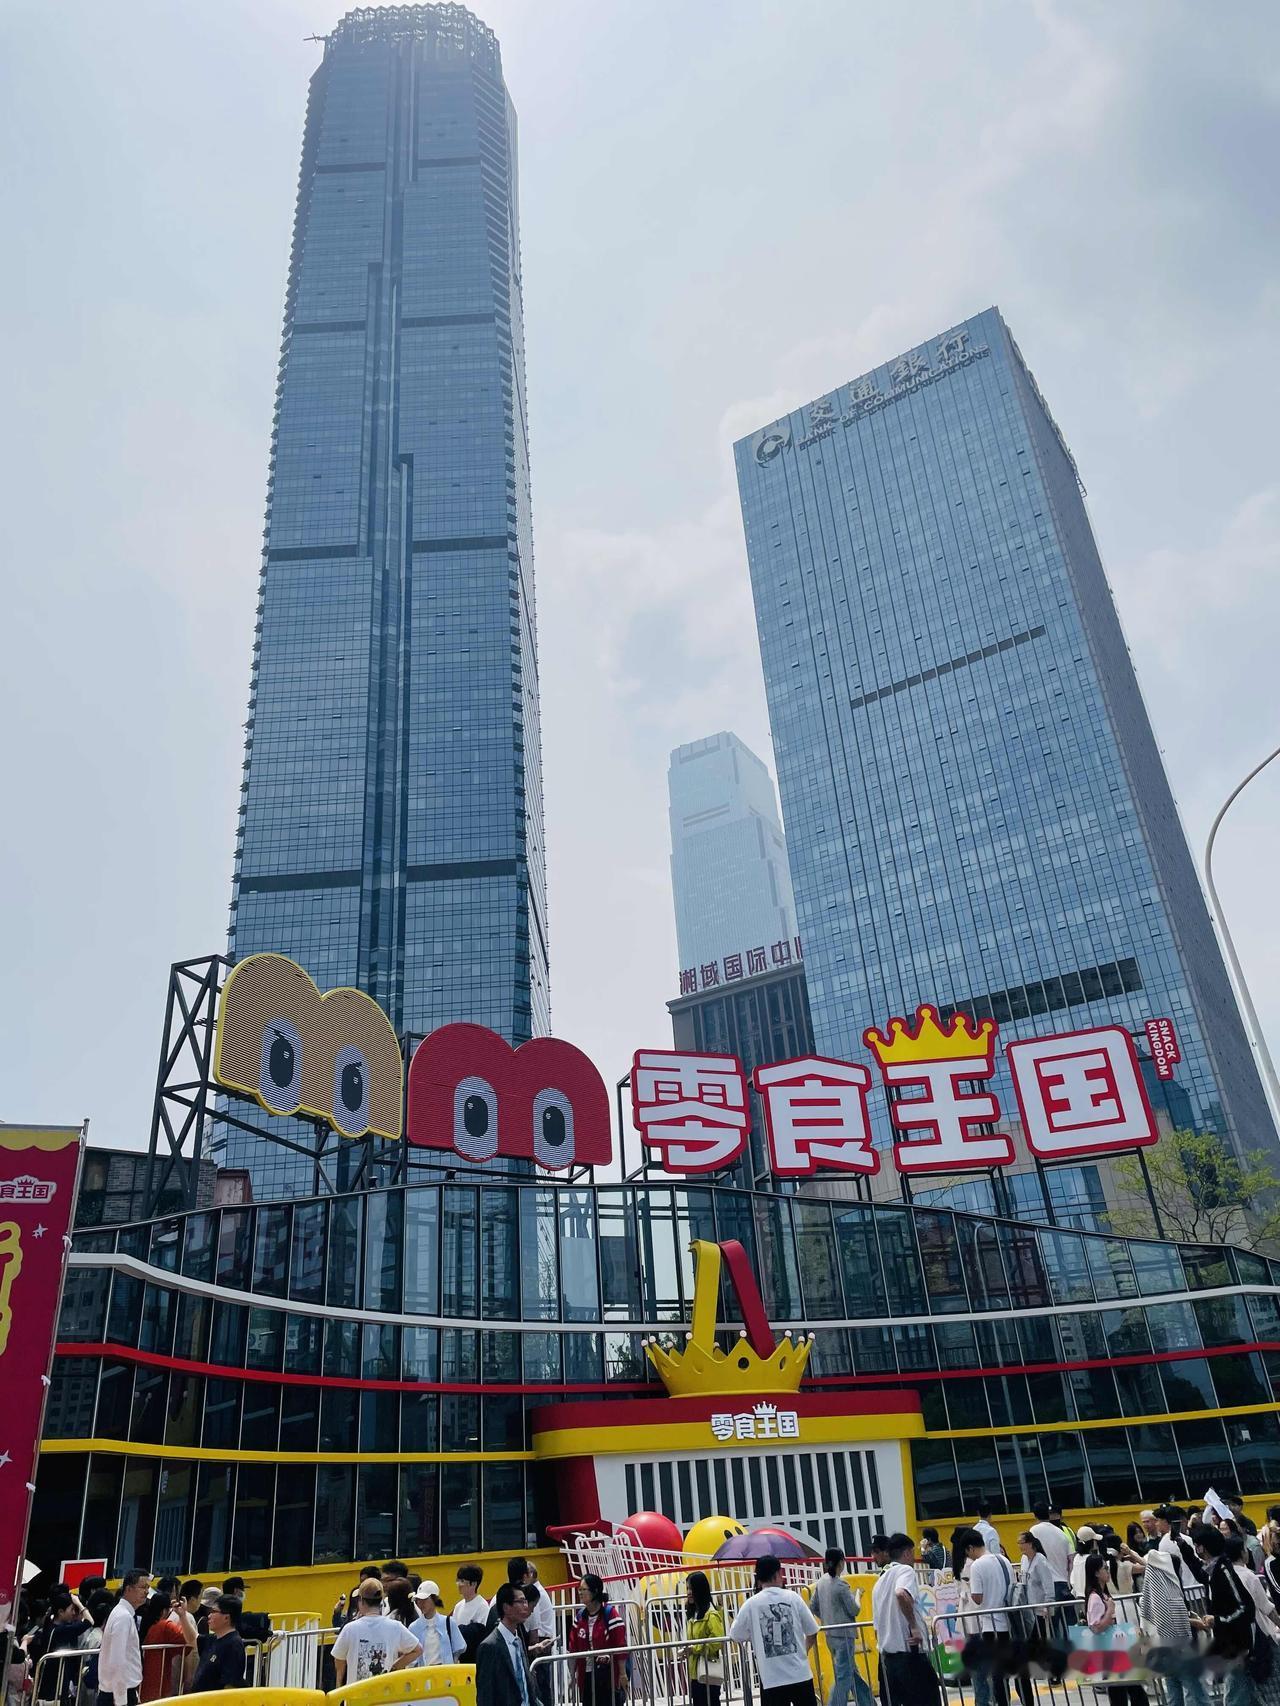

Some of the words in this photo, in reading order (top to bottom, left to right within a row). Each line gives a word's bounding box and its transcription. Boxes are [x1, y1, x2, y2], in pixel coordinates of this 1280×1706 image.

[839, 407, 857, 424] OF
[1147, 1021, 1170, 1076] KINGDOM
[1158, 1020, 1177, 1059] SNACK
[634, 1026, 1154, 1173] 零食王国
[711, 1411, 799, 1440] 零食王国
